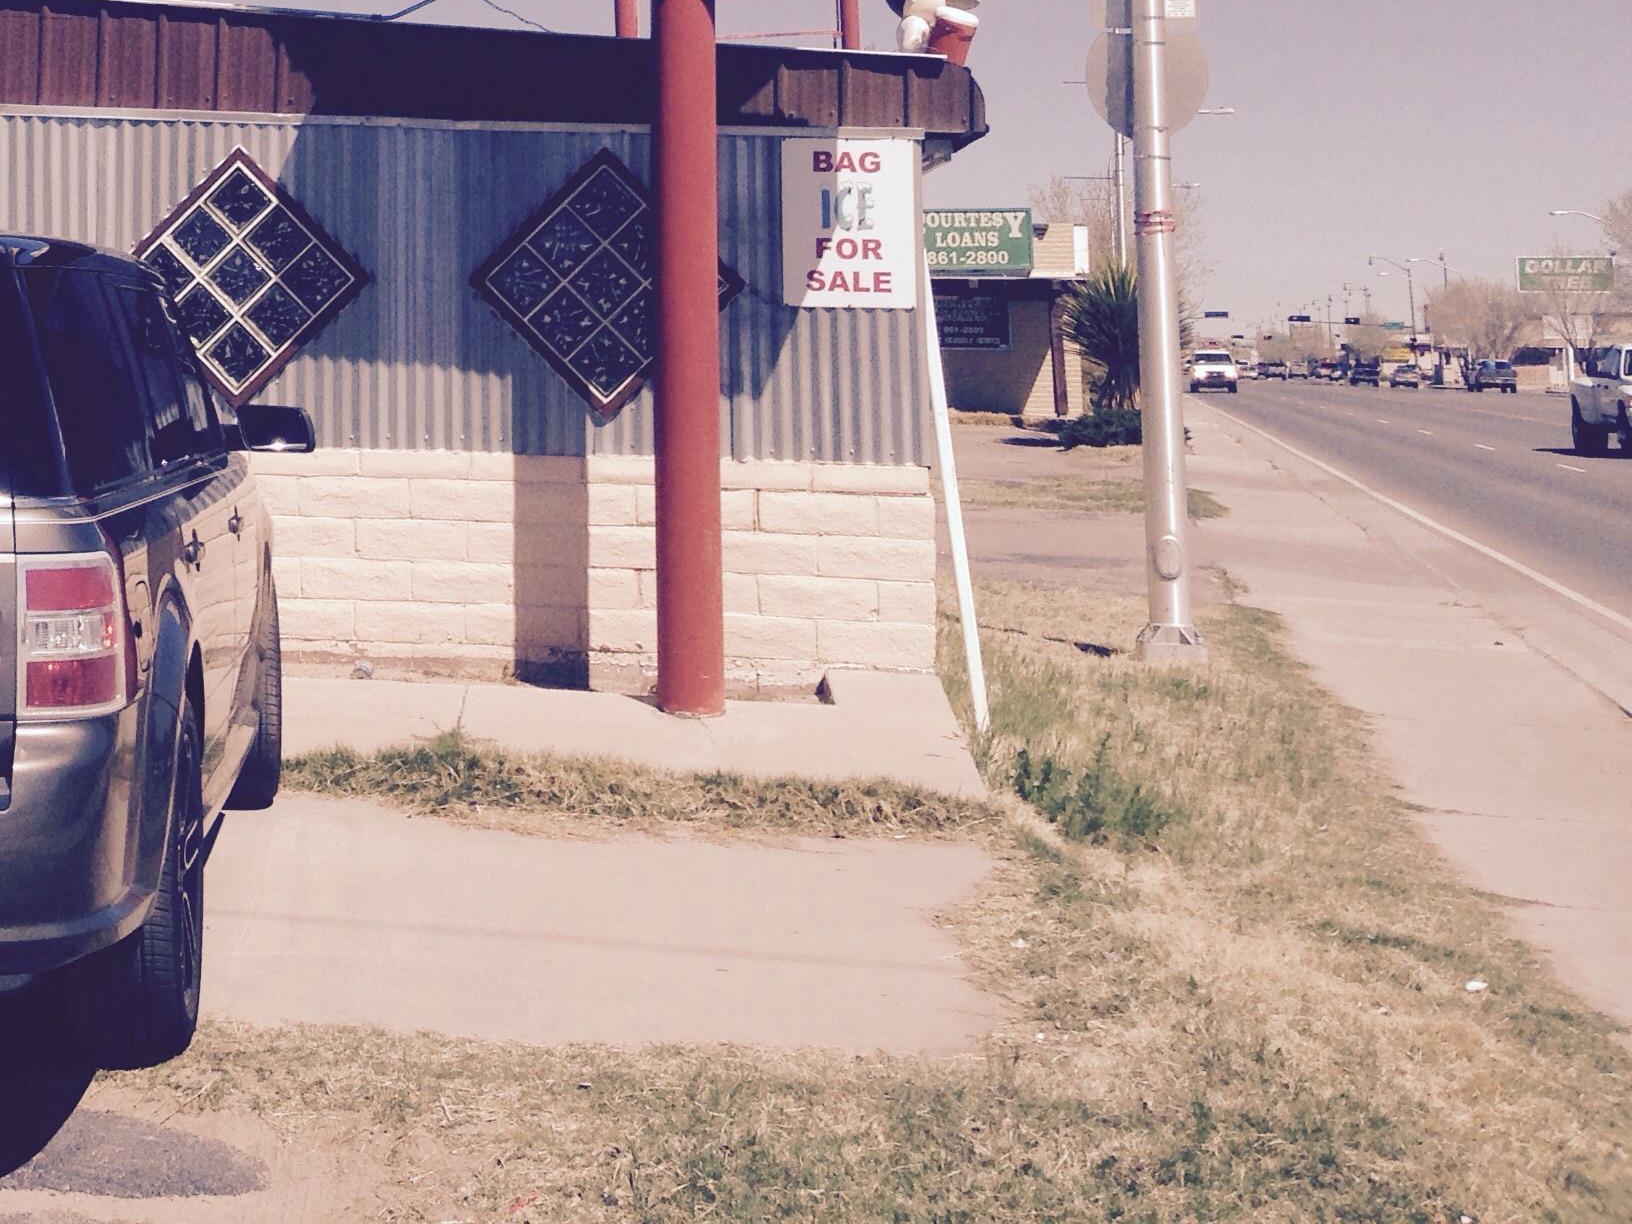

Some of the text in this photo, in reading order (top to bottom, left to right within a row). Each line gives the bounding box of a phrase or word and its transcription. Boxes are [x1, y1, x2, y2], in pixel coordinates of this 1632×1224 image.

[813, 151, 881, 173] BAG
[821, 180, 874, 232] ICE
[923, 212, 1026, 238] OURTESY
[816, 237, 883, 260] FOR
[935, 231, 999, 248] LOANS
[928, 251, 1008, 265] 861-2800
[806, 269, 892, 293] SALE
